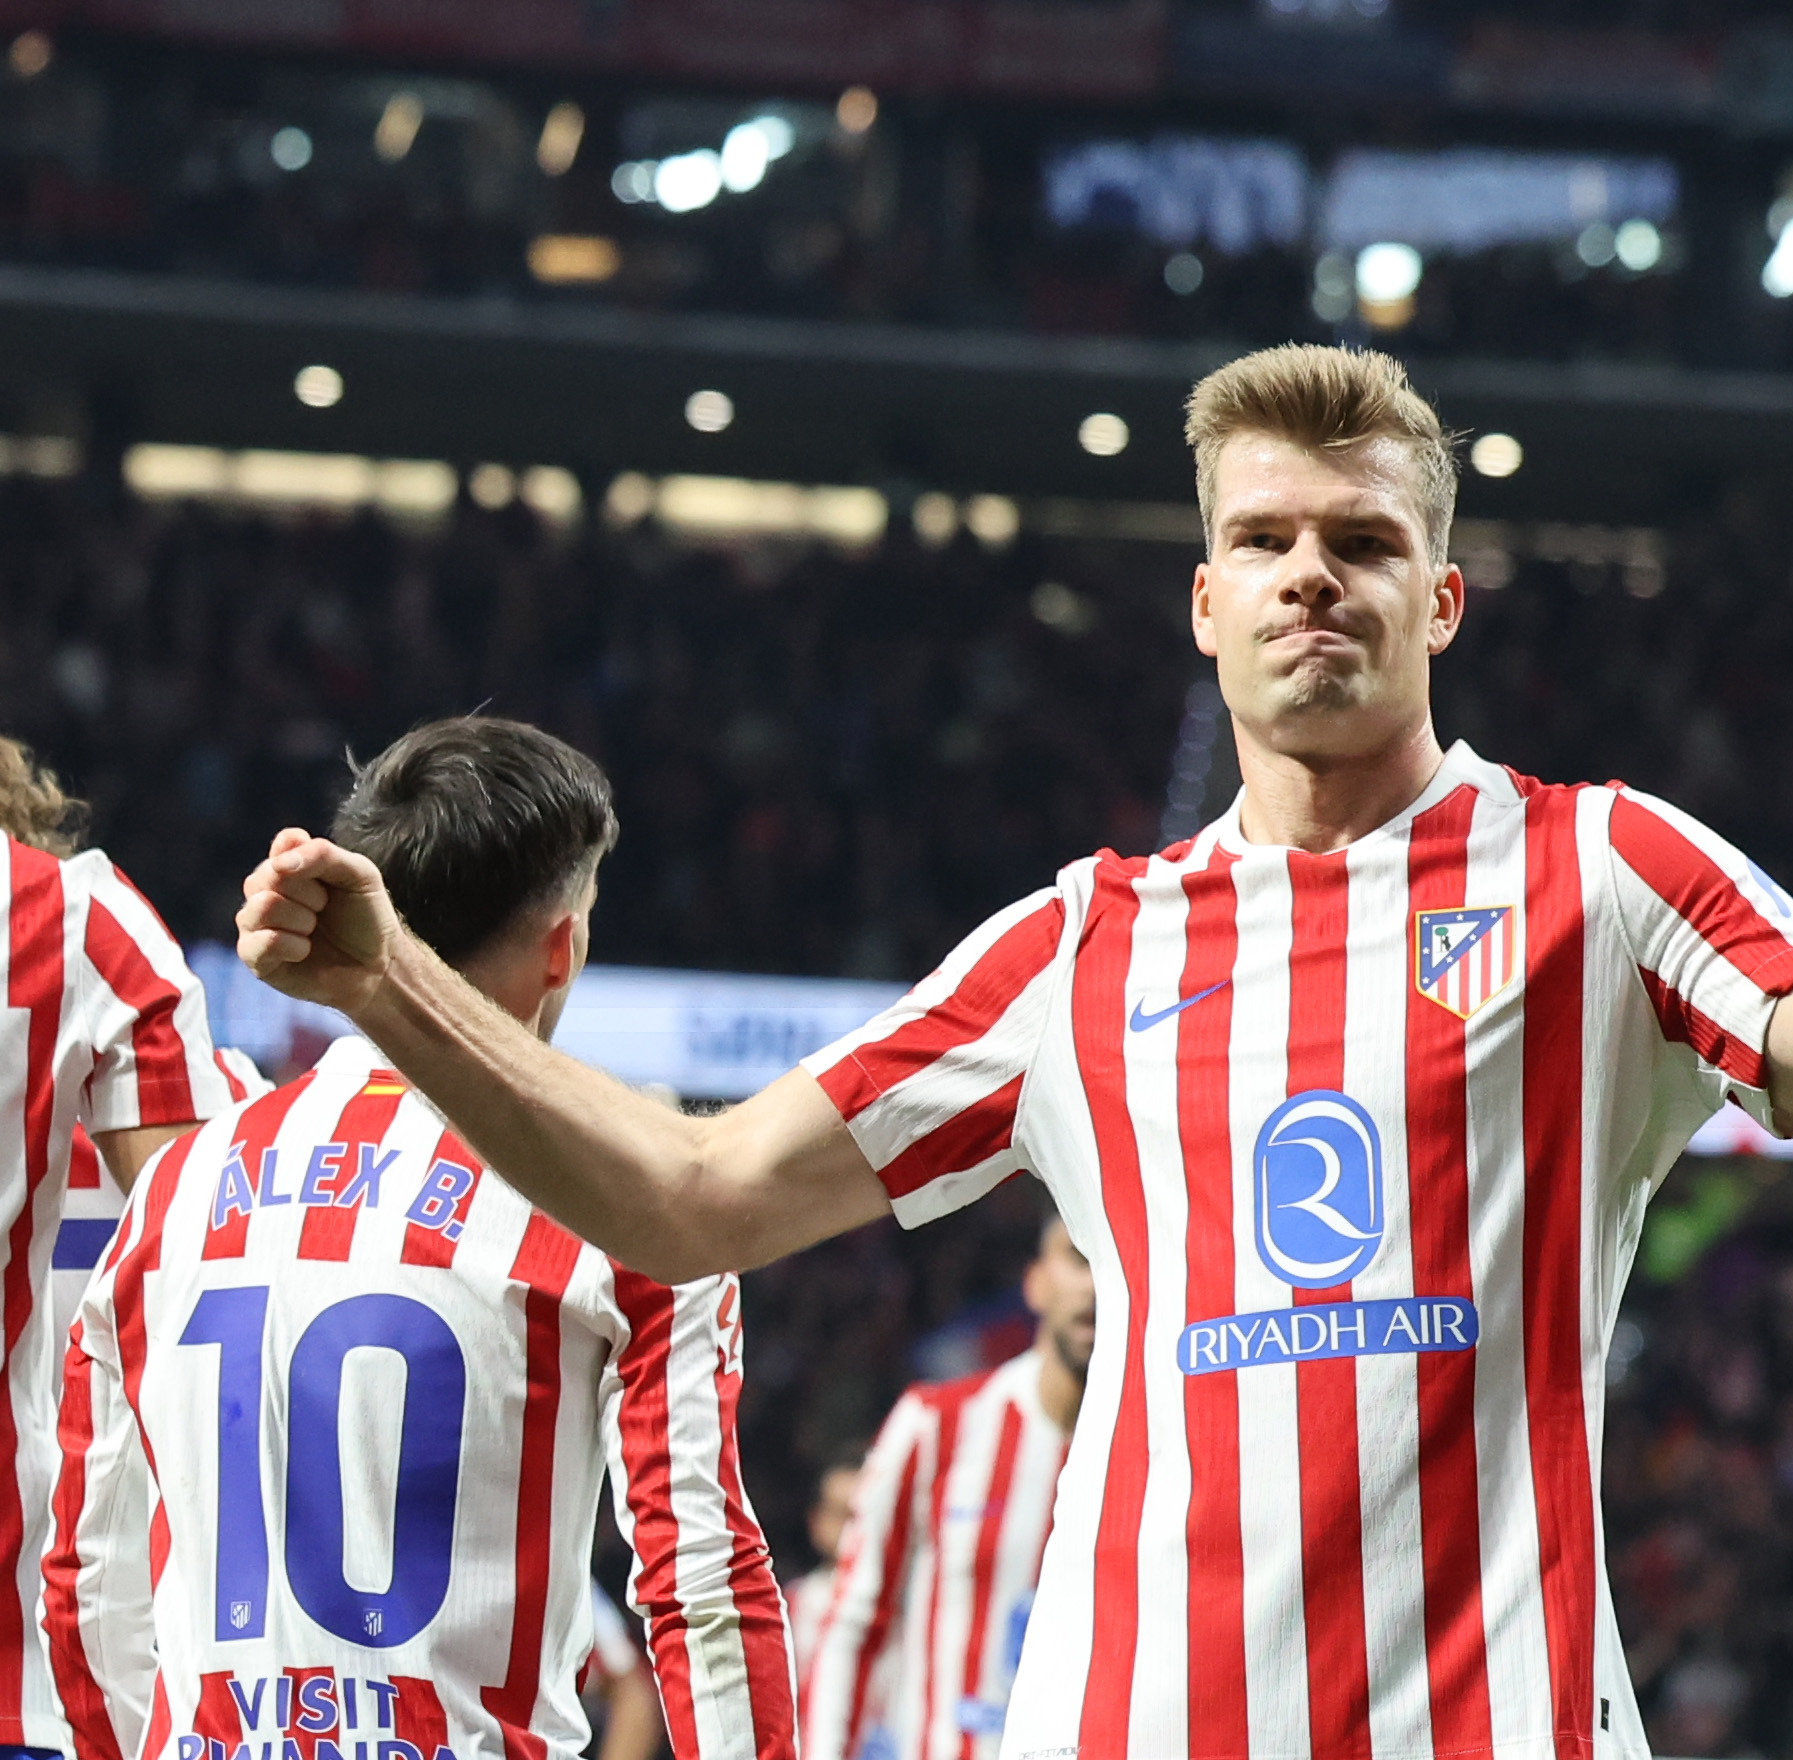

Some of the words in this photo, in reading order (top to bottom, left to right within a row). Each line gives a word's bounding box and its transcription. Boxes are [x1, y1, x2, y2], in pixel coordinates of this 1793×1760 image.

[210, 1139, 402, 1229] ÁLEX
[405, 1158, 477, 1241] B.
[1188, 1310, 1366, 1369] RIYADH
[1383, 1303, 1467, 1347] AIR
[177, 1285, 466, 1648] 10
[229, 1675, 399, 1733] VISIT
